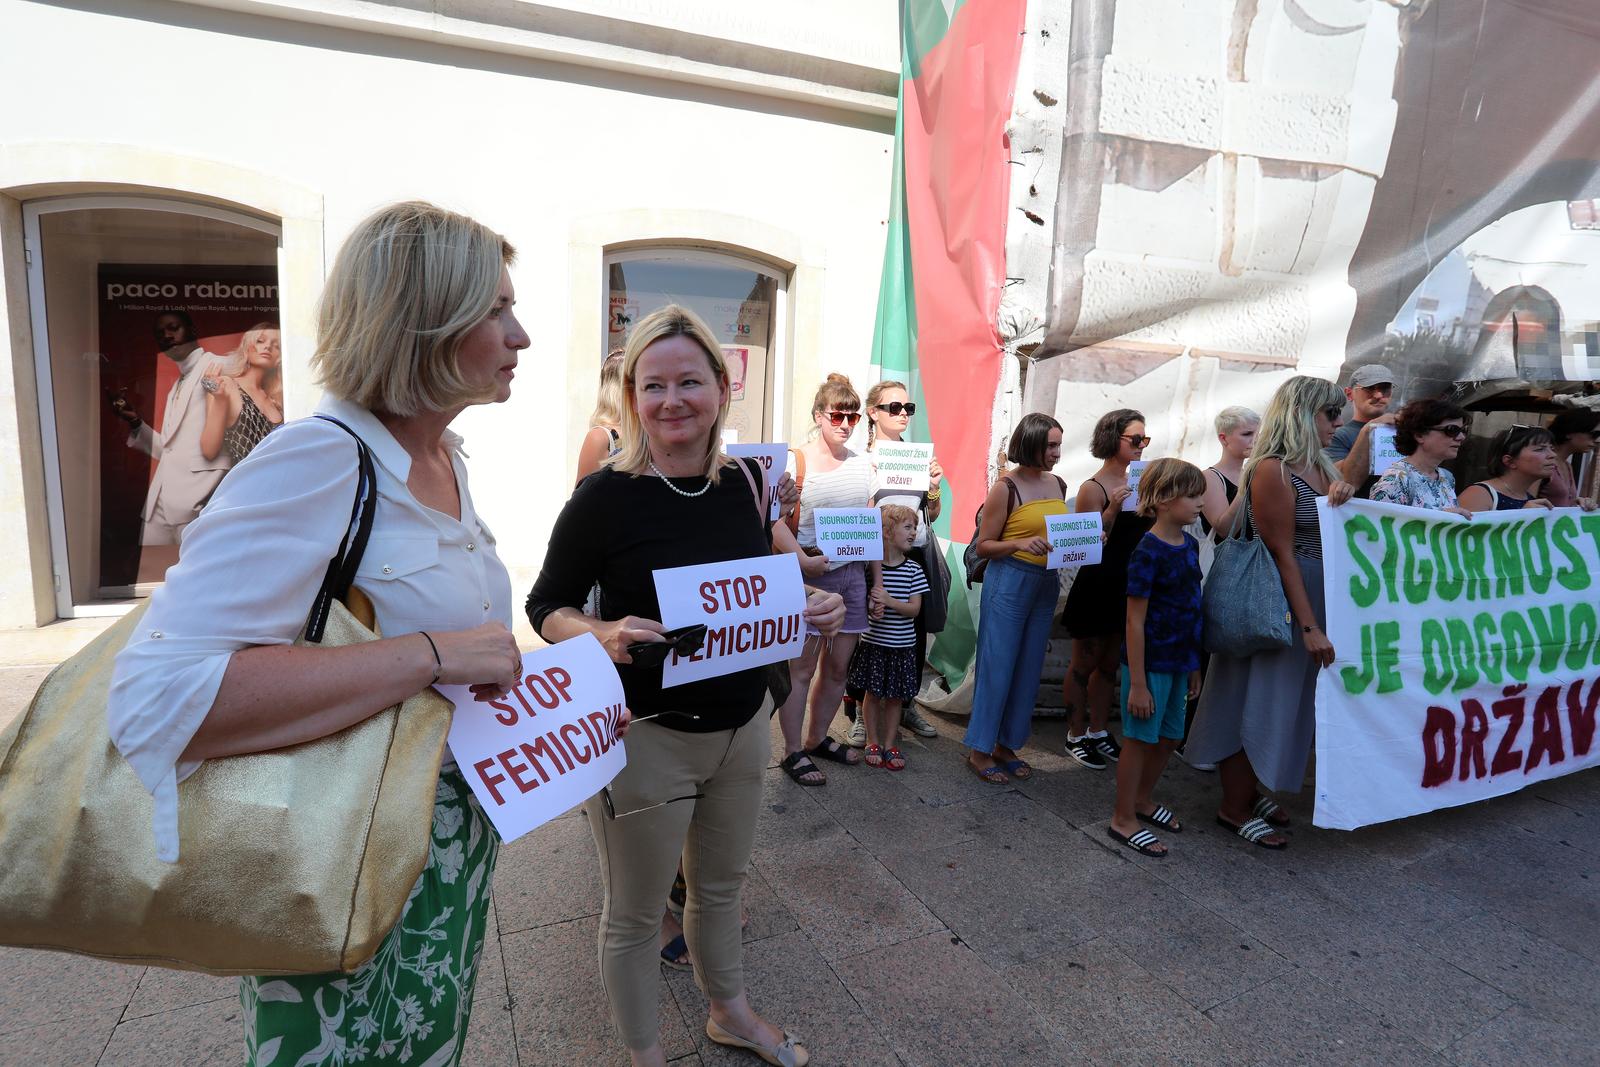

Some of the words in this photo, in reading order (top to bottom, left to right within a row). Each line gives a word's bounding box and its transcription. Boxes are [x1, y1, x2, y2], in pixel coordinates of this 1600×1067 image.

[107, 283, 178, 300] paco
[171, 304, 186, 312] Lady
[879, 448, 913, 458] SIGURNOST
[913, 449, 928, 458] ŽENA
[877, 462, 884, 470] JE
[885, 462, 928, 471] ODGOVORNOST
[887, 474, 912, 485] DRŽAVE!
[819, 513, 858, 525] SIGURNOST
[859, 513, 876, 525] ŽENA
[1050, 521, 1082, 532] SIGURNOST
[1083, 519, 1098, 530] ŽENA
[820, 532, 830, 541] JE
[830, 531, 879, 540] ODGOVORNOST
[1059, 535, 1100, 547] ODGOVORNOST
[837, 544, 865, 556] DRŽAVE!
[1063, 551, 1086, 563] DRŽAVE!
[700, 574, 767, 614] STOP
[671, 613, 801, 666] MICIDU!
[1339, 620, 1403, 695] JE
[1421, 602, 1600, 696] ODGOVO
[487, 666, 572, 727] STOP
